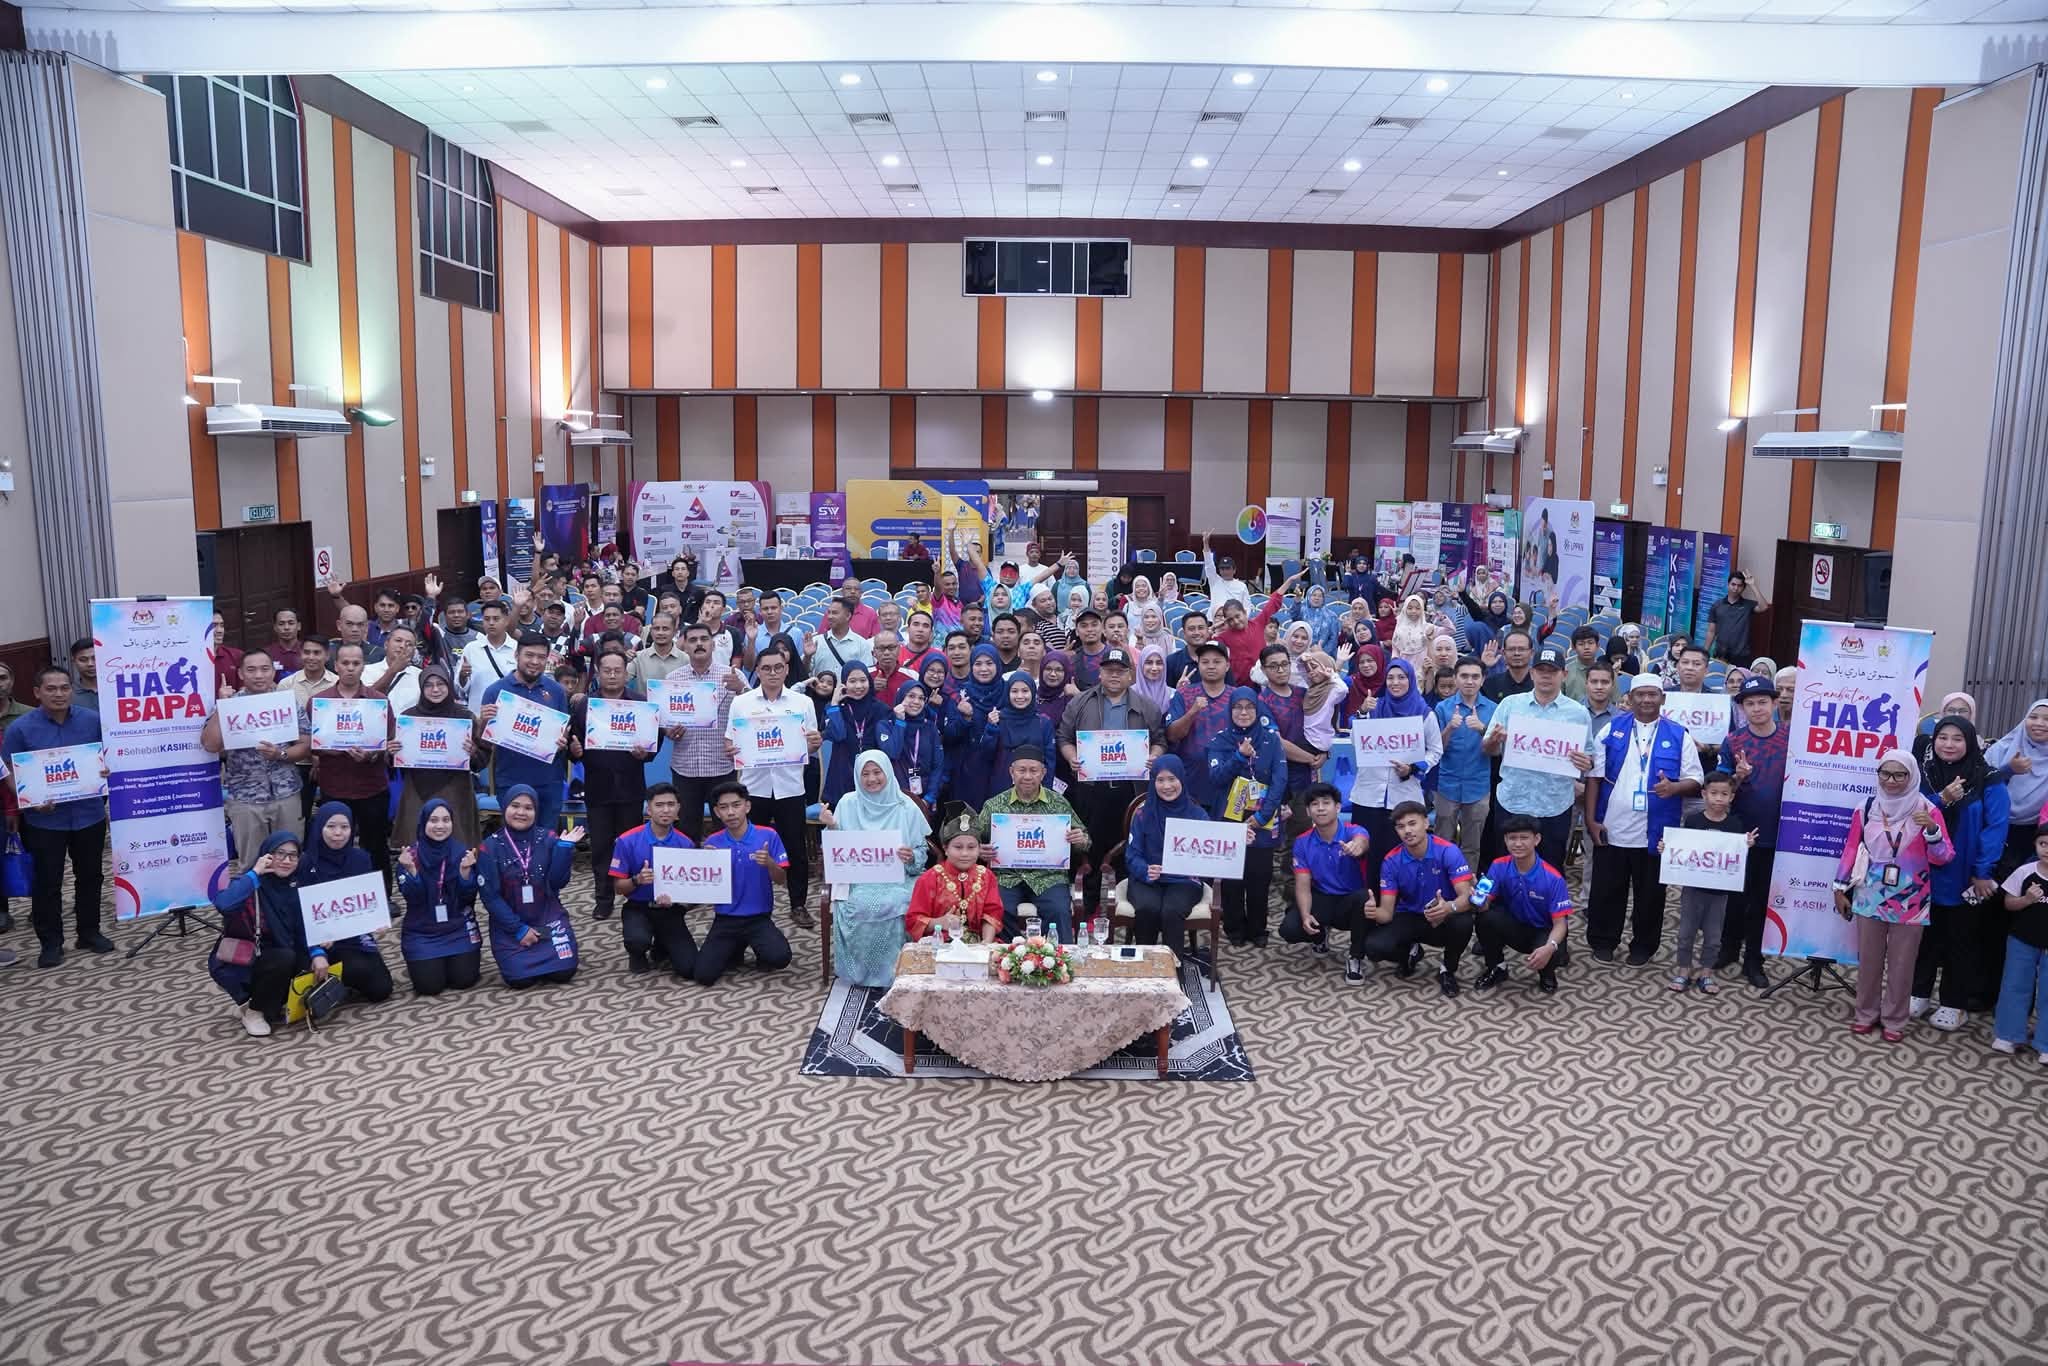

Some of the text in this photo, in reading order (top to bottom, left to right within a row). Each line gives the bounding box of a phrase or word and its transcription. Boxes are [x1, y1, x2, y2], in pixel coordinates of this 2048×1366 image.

[1668, 553, 1678, 633] KASI
[117, 693, 207, 723] BAPA
[669, 702, 695, 712] BAPA
[226, 707, 292, 731] KASIH
[1662, 709, 1724, 726] KASIH
[336, 721, 364, 731] BAPA
[512, 721, 540, 737] BAPA
[610, 722, 637, 732] BAPA
[117, 742, 203, 756] #SehebatKASIHBap
[419, 739, 448, 749] BAPA
[757, 738, 785, 748] BAPA
[1360, 733, 1420, 750] KASIH
[1513, 733, 1579, 757] KASIH
[1100, 753, 1127, 761] BAPA
[46, 770, 79, 783] BAPA
[1798, 778, 1877, 796] #SehebatKASIHB
[1016, 839, 1046, 849] BAPA
[1173, 836, 1237, 856] KASIH
[832, 847, 894, 863] KASIH
[1669, 847, 1741, 871] KASIH
[662, 864, 722, 883] KASIH
[1803, 880, 1828, 889] LPPKN
[312, 891, 377, 921] KASIH
[1793, 899, 1827, 912] KASIH
